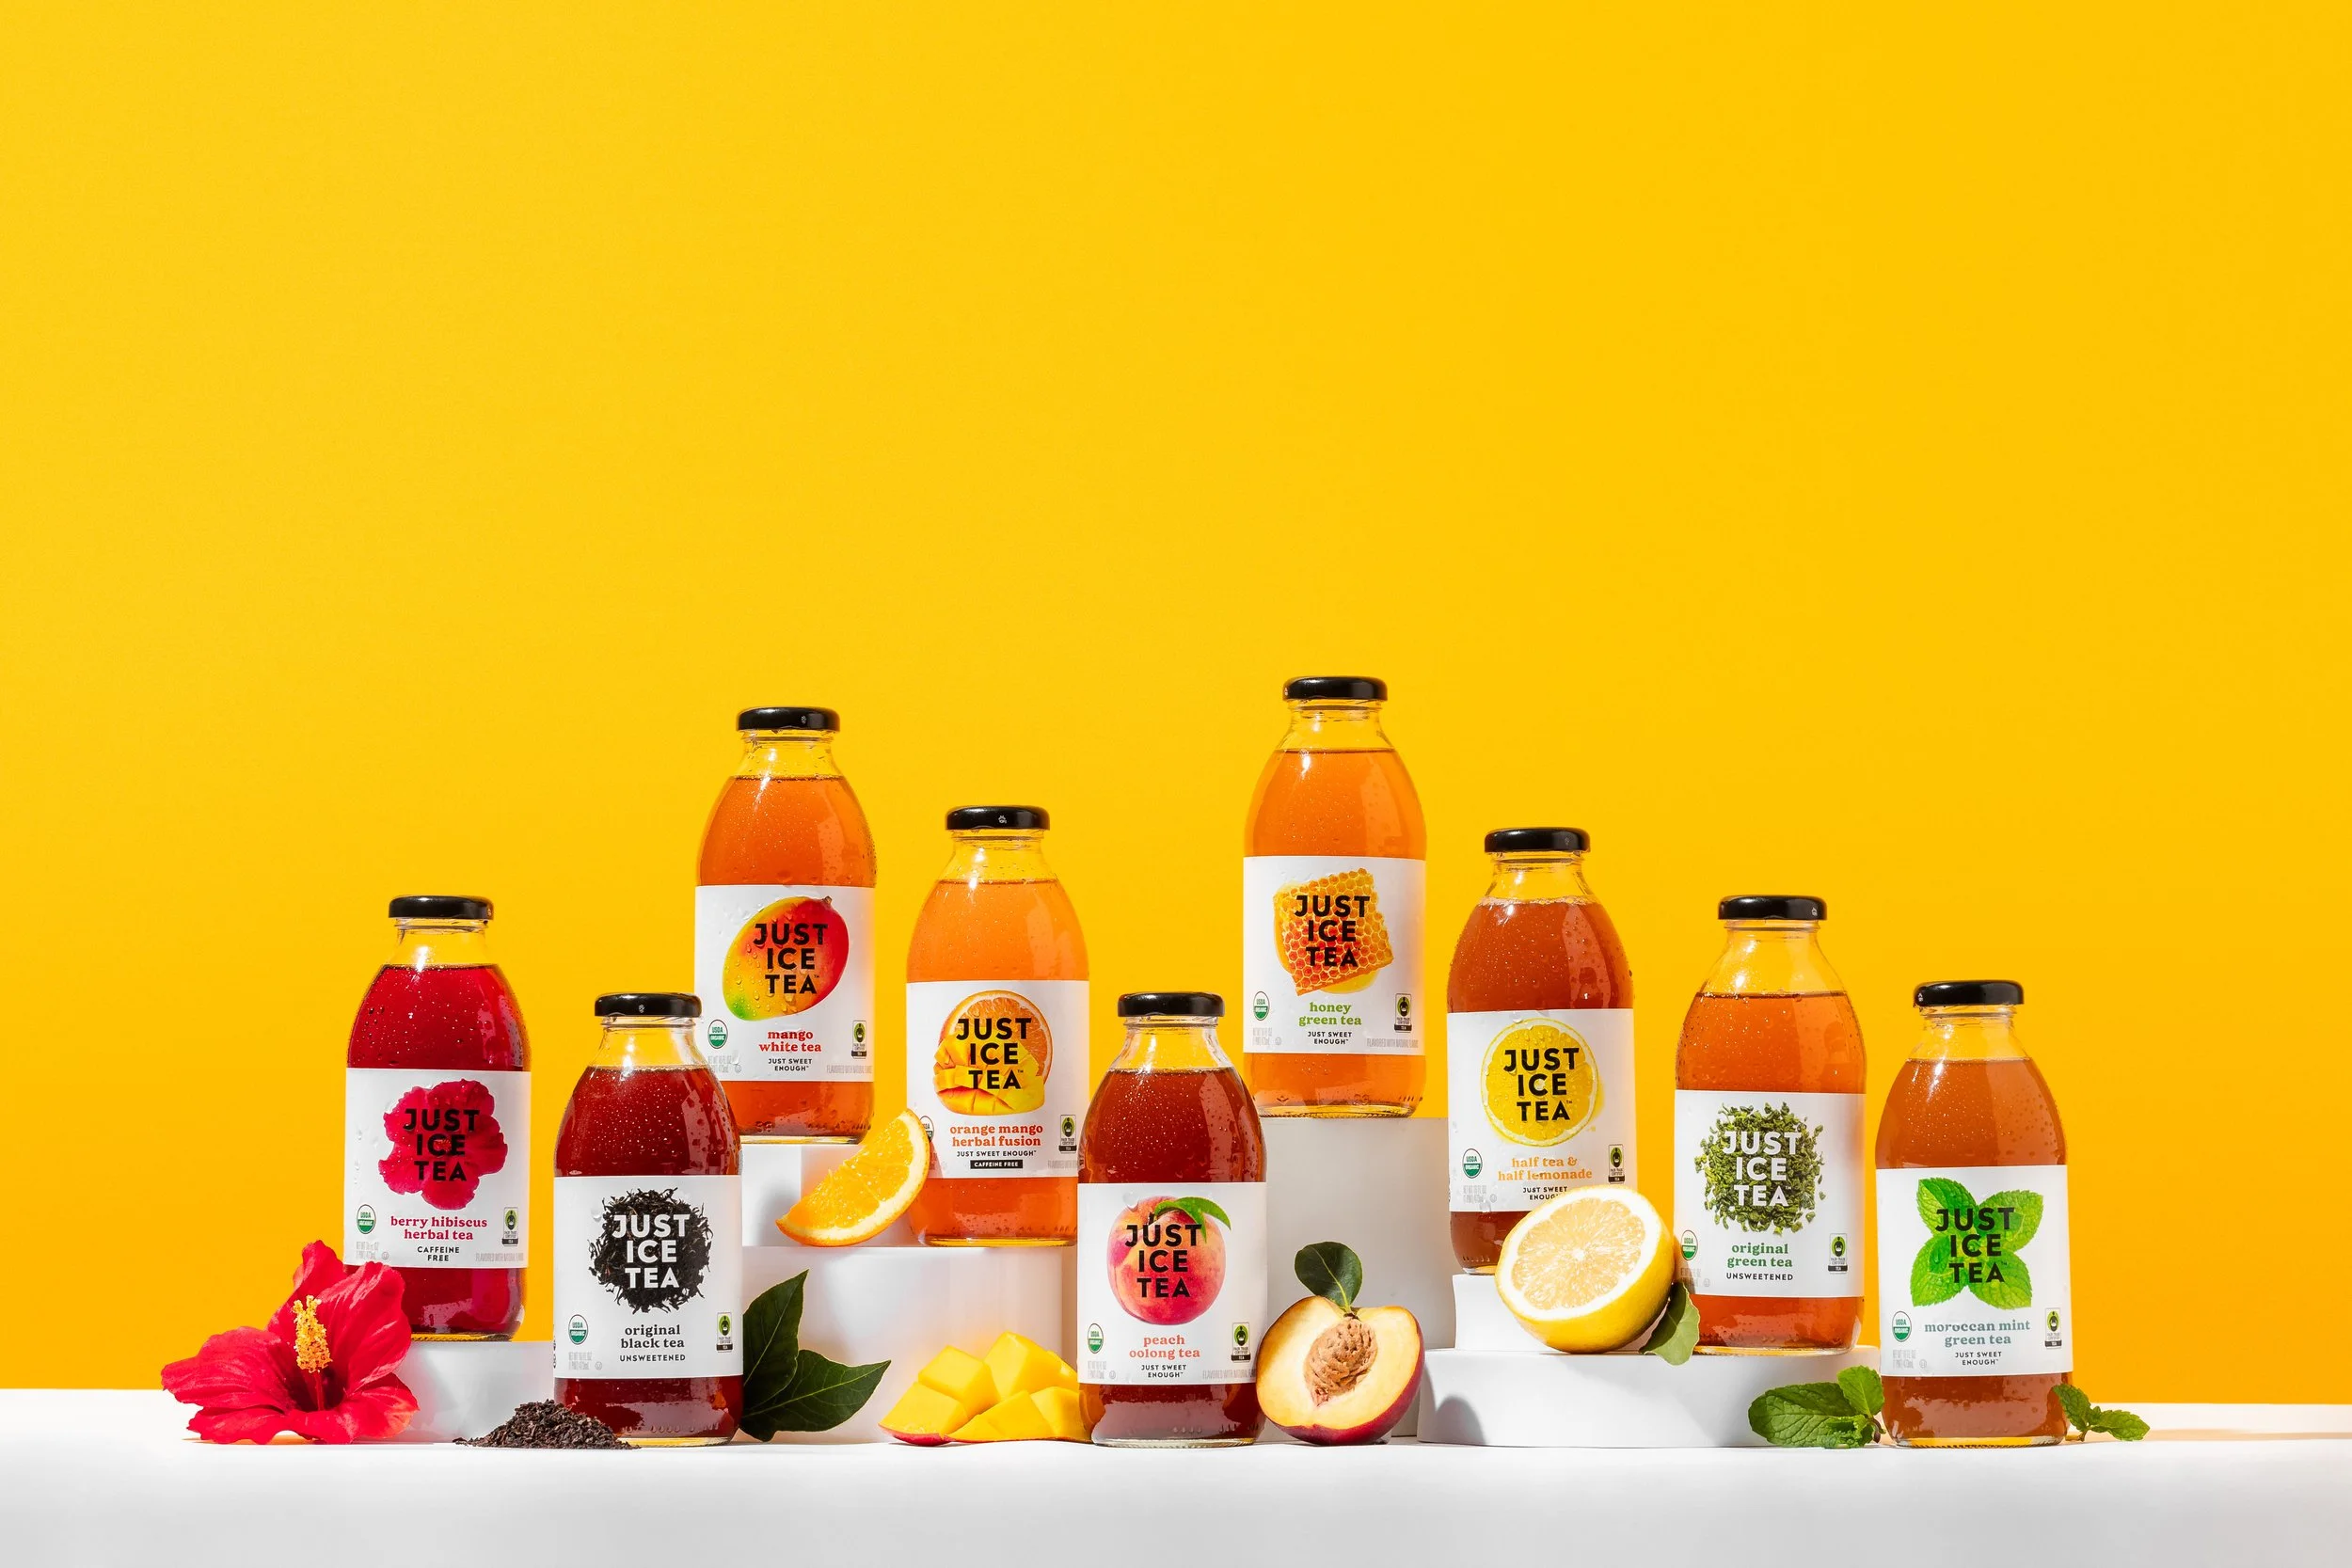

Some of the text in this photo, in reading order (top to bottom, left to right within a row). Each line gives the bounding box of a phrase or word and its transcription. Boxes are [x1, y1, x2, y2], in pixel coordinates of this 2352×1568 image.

[1295, 895, 1370, 917] JUST
[753, 924, 828, 945] JUST
[1308, 919, 1356, 942] ICE
[767, 948, 815, 970] ICE
[1310, 1002, 1351, 1014] honey
[956, 1018, 1032, 1040] JUST
[1299, 1016, 1362, 1027] green tea
[768, 1030, 813, 1041] mango
[759, 1042, 822, 1052] white tea
[970, 1043, 1018, 1065] ICE
[1503, 1048, 1579, 1072] JUST
[1518, 1073, 1567, 1096] ICE
[403, 1109, 480, 1131] JUST
[950, 1125, 1043, 1136] orange mango
[416, 1134, 466, 1156] ICE
[952, 1136, 1041, 1147] herbal fusion
[1723, 1131, 1801, 1155] JUST
[1512, 1156, 1577, 1167] half tea &
[1736, 1157, 1787, 1180] ICE
[1498, 1169, 1592, 1181] half lemonade
[391, 1216, 487, 1228] berry hibiscus
[612, 1214, 690, 1238] JUST
[1935, 1207, 2014, 1231] JUST
[404, 1229, 473, 1240] herbal tea
[1125, 1224, 1202, 1247] JUST
[627, 1240, 677, 1263] ICE
[1732, 1243, 1788, 1256] original
[1951, 1234, 2002, 1257] ICE
[1138, 1250, 1188, 1273] ICE
[1727, 1257, 1793, 1268] green tea
[625, 1324, 680, 1337] original
[1924, 1320, 2030, 1332] moroccan mint
[621, 1338, 684, 1348] black tea
[1144, 1334, 1185, 1347] peach
[1945, 1335, 2011, 1347] green tea
[1129, 1347, 1200, 1360] oolong tea
